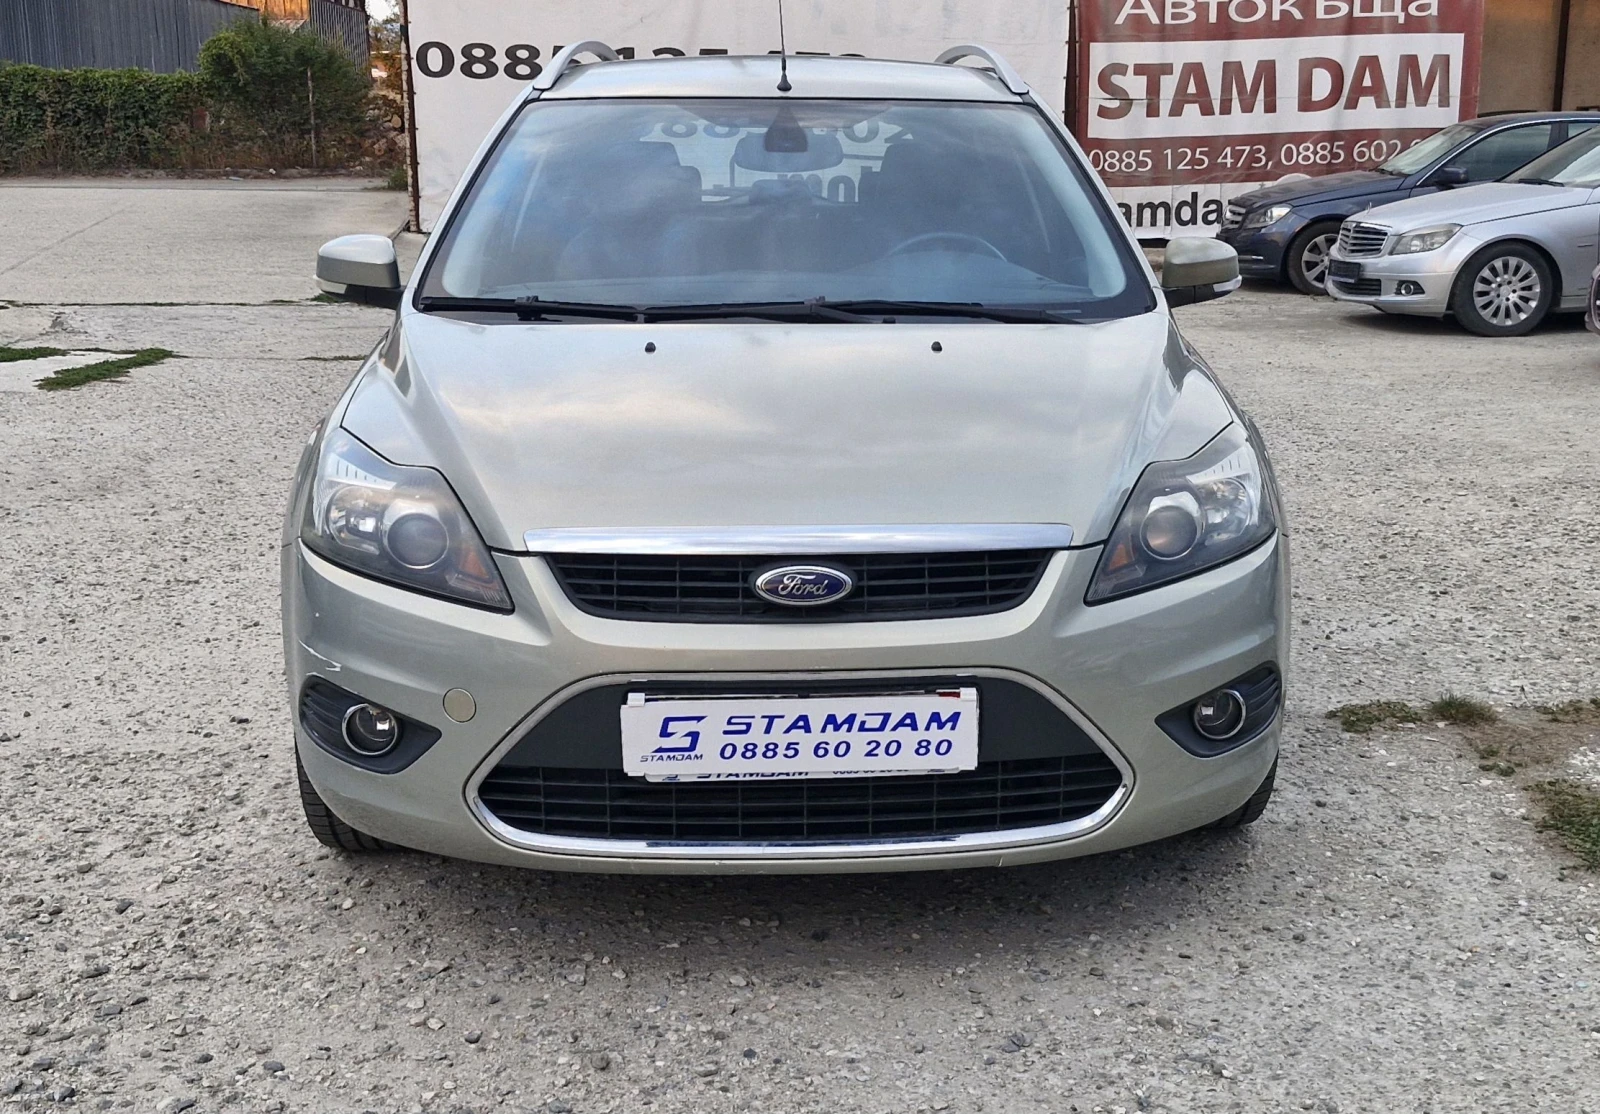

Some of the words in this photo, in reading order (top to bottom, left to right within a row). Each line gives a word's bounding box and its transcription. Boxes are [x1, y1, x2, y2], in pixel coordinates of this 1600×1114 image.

[416, 41, 582, 80] 088
[1096, 59, 1277, 120] STAM
[1297, 54, 1450, 113] DAM
[1090, 149, 1152, 172] 0885
[1163, 147, 1209, 170] 125
[1217, 145, 1273, 169] 473,
[1280, 141, 1345, 166] 0885
[778, 573, 828, 595] Ford
[722, 711, 962, 736] STAMDAM
[640, 753, 704, 763] STAMDAM
[719, 742, 800, 760] 0885
[812, 740, 851, 759] 60
[863, 739, 902, 757] 20
[914, 738, 953, 757] 80
